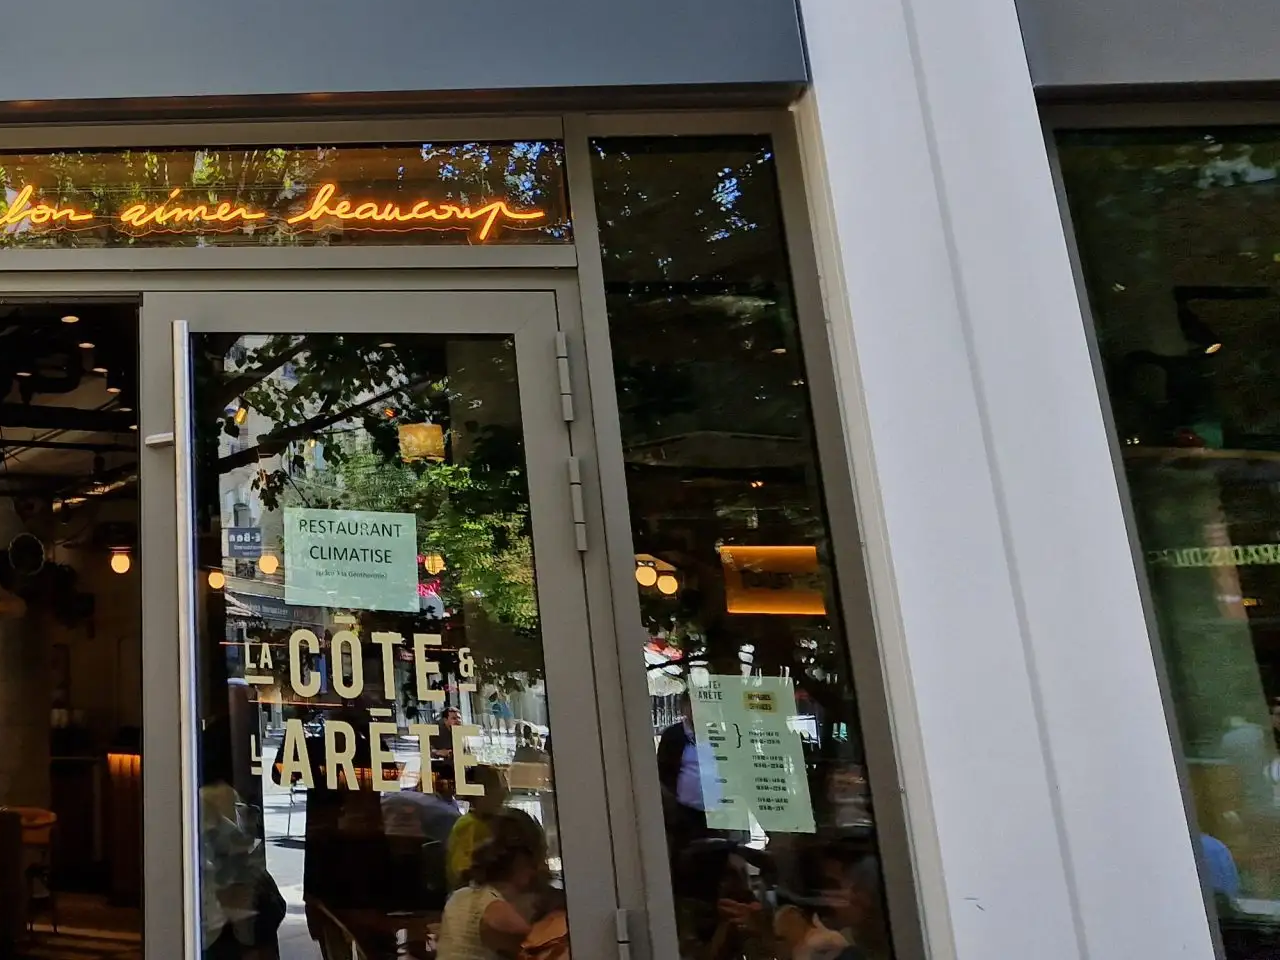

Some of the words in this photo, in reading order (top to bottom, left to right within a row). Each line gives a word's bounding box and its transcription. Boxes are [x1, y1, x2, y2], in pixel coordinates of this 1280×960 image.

[121, 188, 266, 227] aimer
[287, 183, 544, 240] beaucoup
[298, 518, 402, 539] RESTAURANT
[309, 544, 393, 565] CLIMATISE
[245, 642, 273, 669] LA
[458, 647, 475, 678] &
